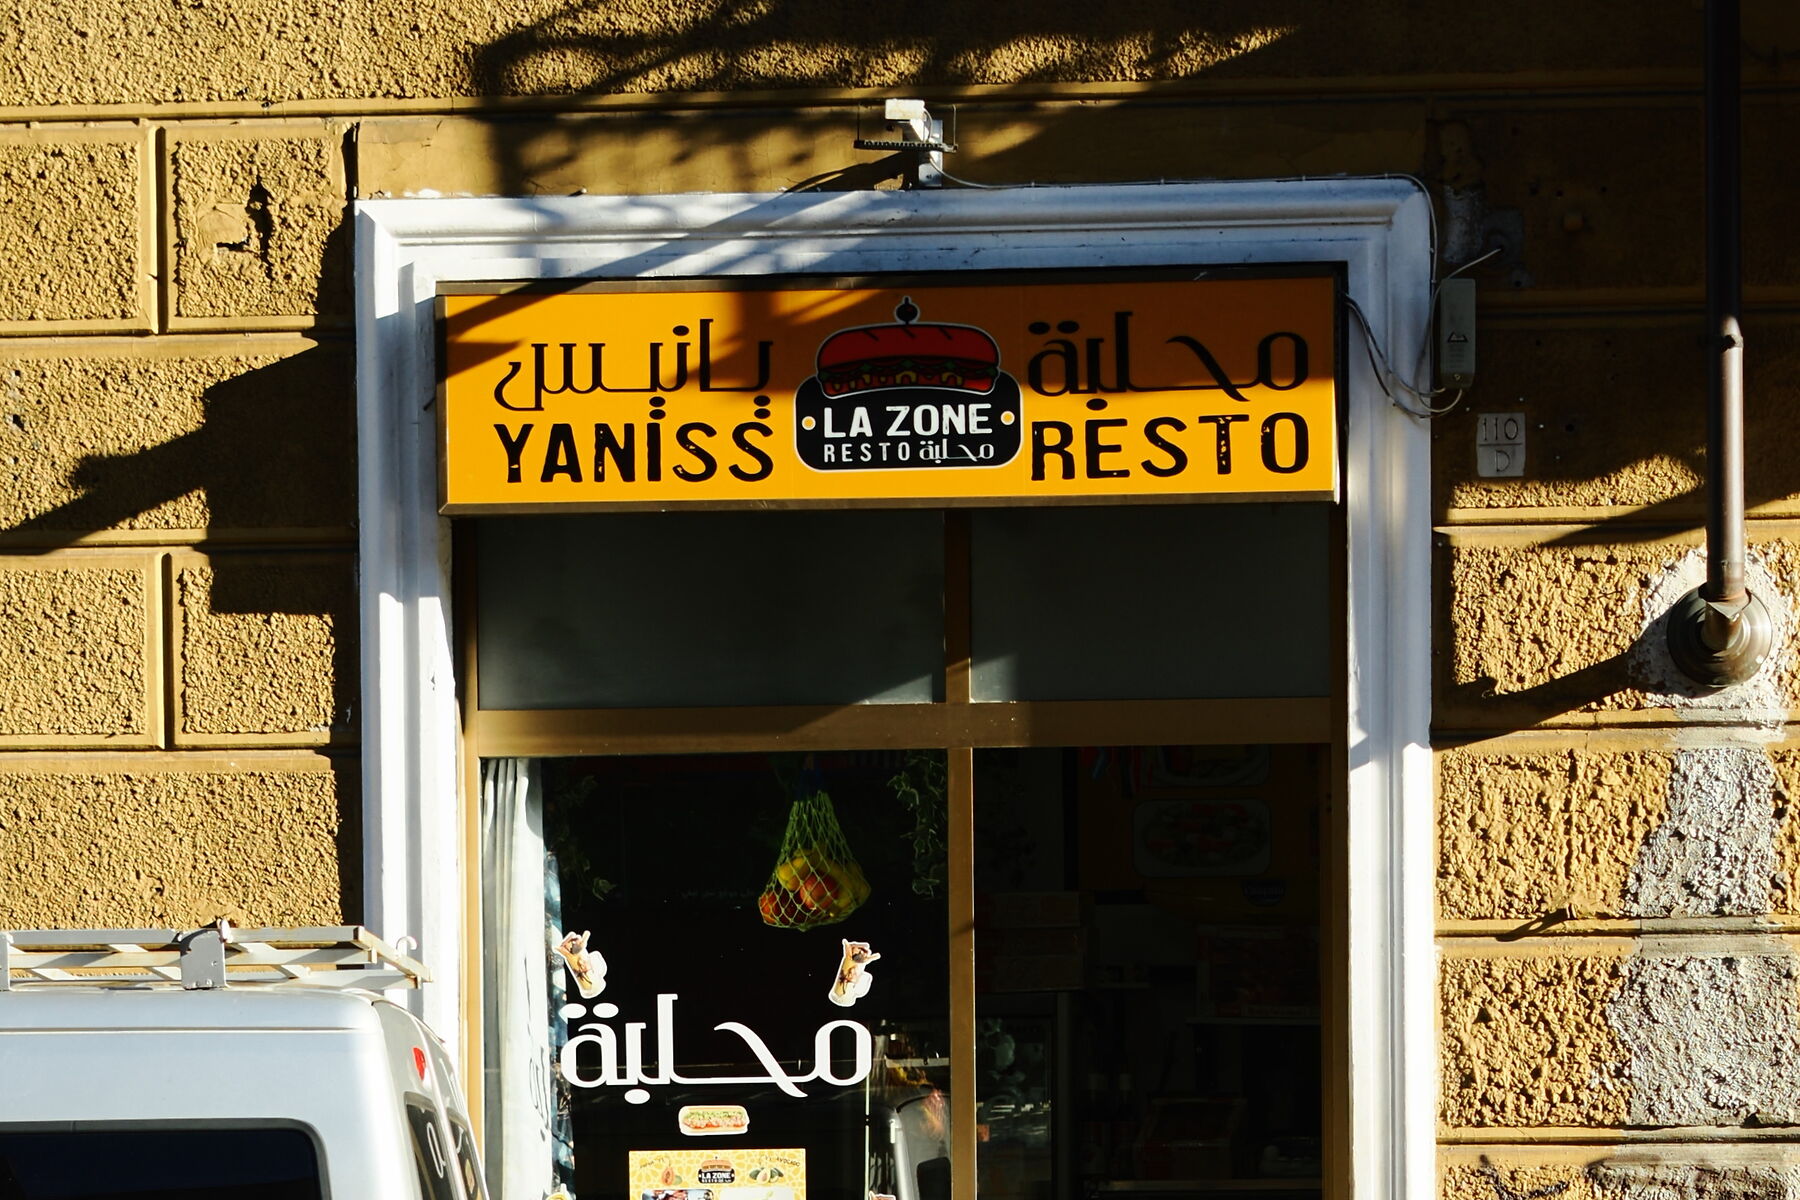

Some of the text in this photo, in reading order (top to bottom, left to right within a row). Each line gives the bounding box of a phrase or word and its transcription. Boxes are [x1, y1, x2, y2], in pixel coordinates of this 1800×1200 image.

[1027, 311, 1310, 412] محلبة
[823, 402, 993, 438] LA ZONE
[1031, 411, 1310, 482] RESTO
[1482, 417, 1519, 441] 110
[823, 441, 911, 463] RESTO
[558, 992, 873, 1105] محلبة
